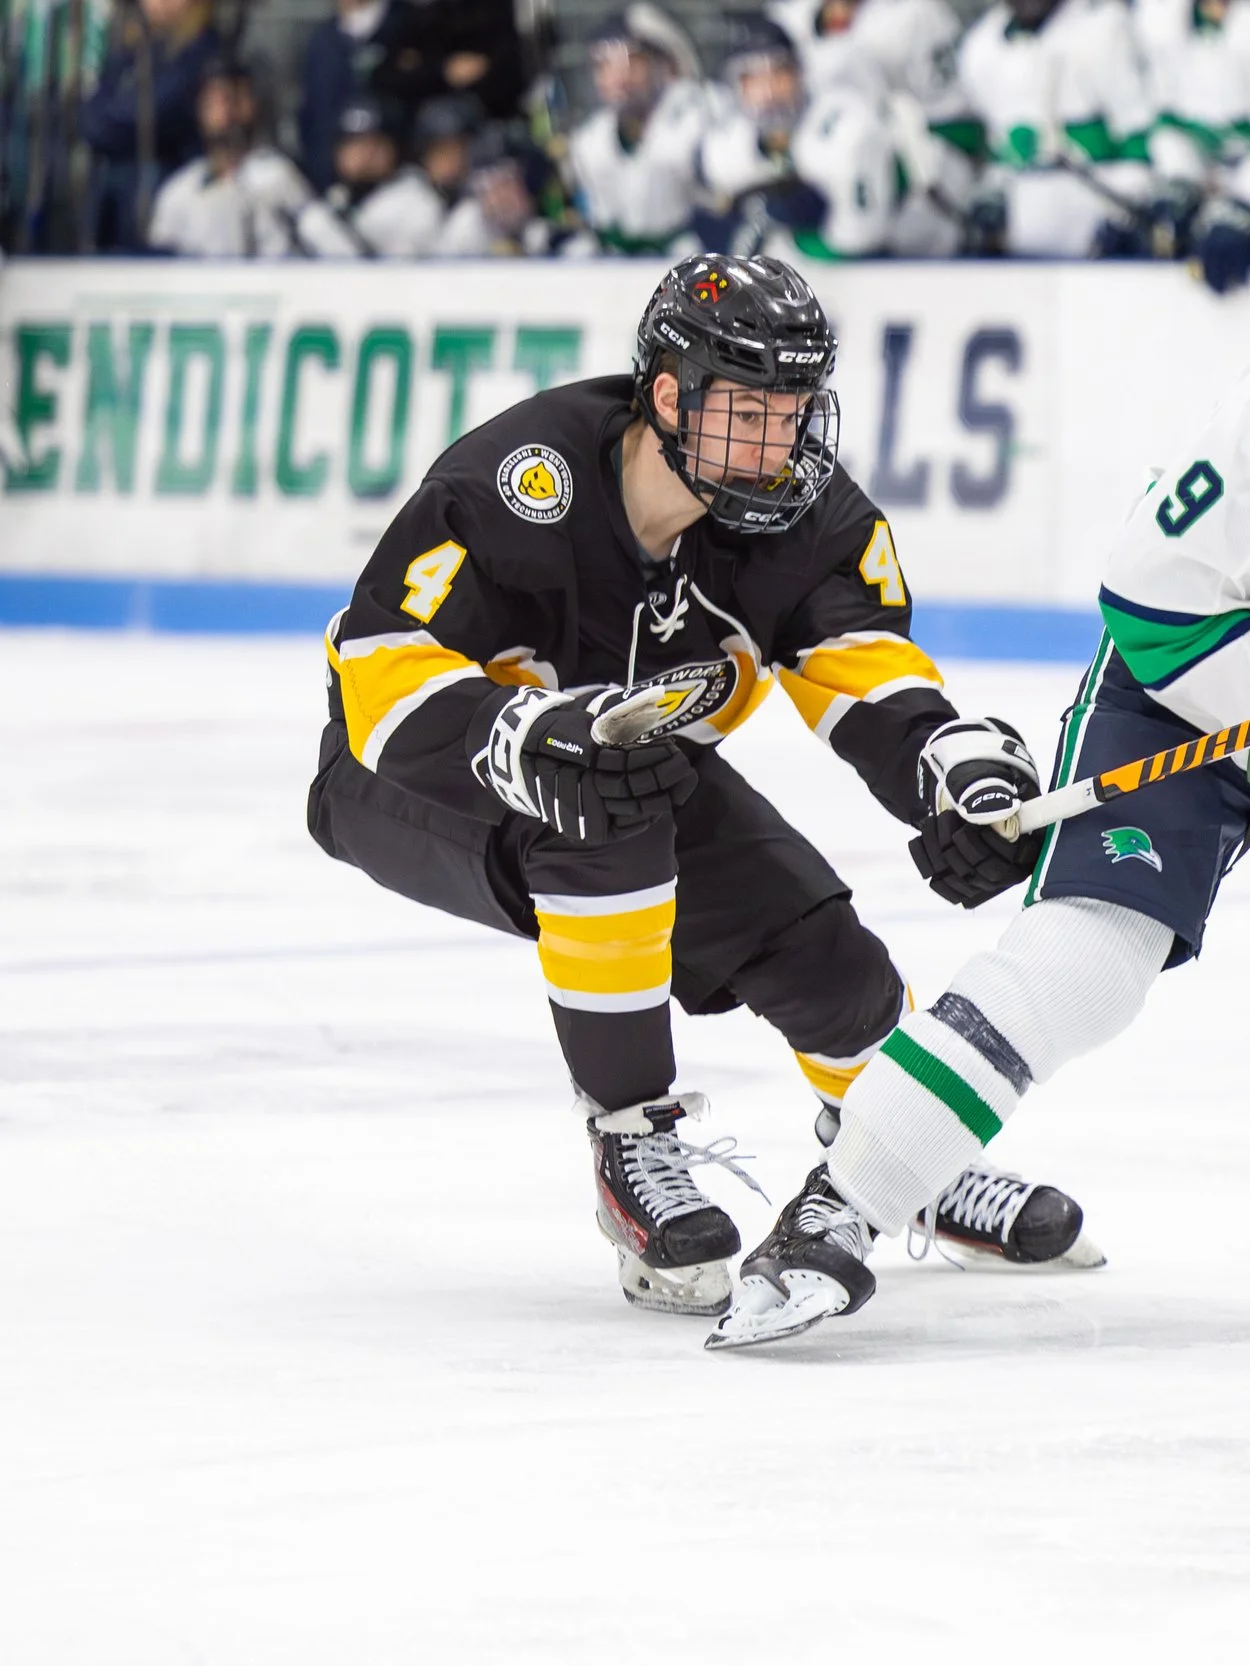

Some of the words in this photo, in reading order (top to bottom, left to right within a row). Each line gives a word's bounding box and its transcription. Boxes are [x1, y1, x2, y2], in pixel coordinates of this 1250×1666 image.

[659, 322, 691, 350] CCM
[777, 350, 825, 365] CCM
[1156, 460, 1224, 538] 9
[400, 539, 468, 624] 4
[859, 520, 907, 607] 4
[971, 792, 1011, 809] CCM
